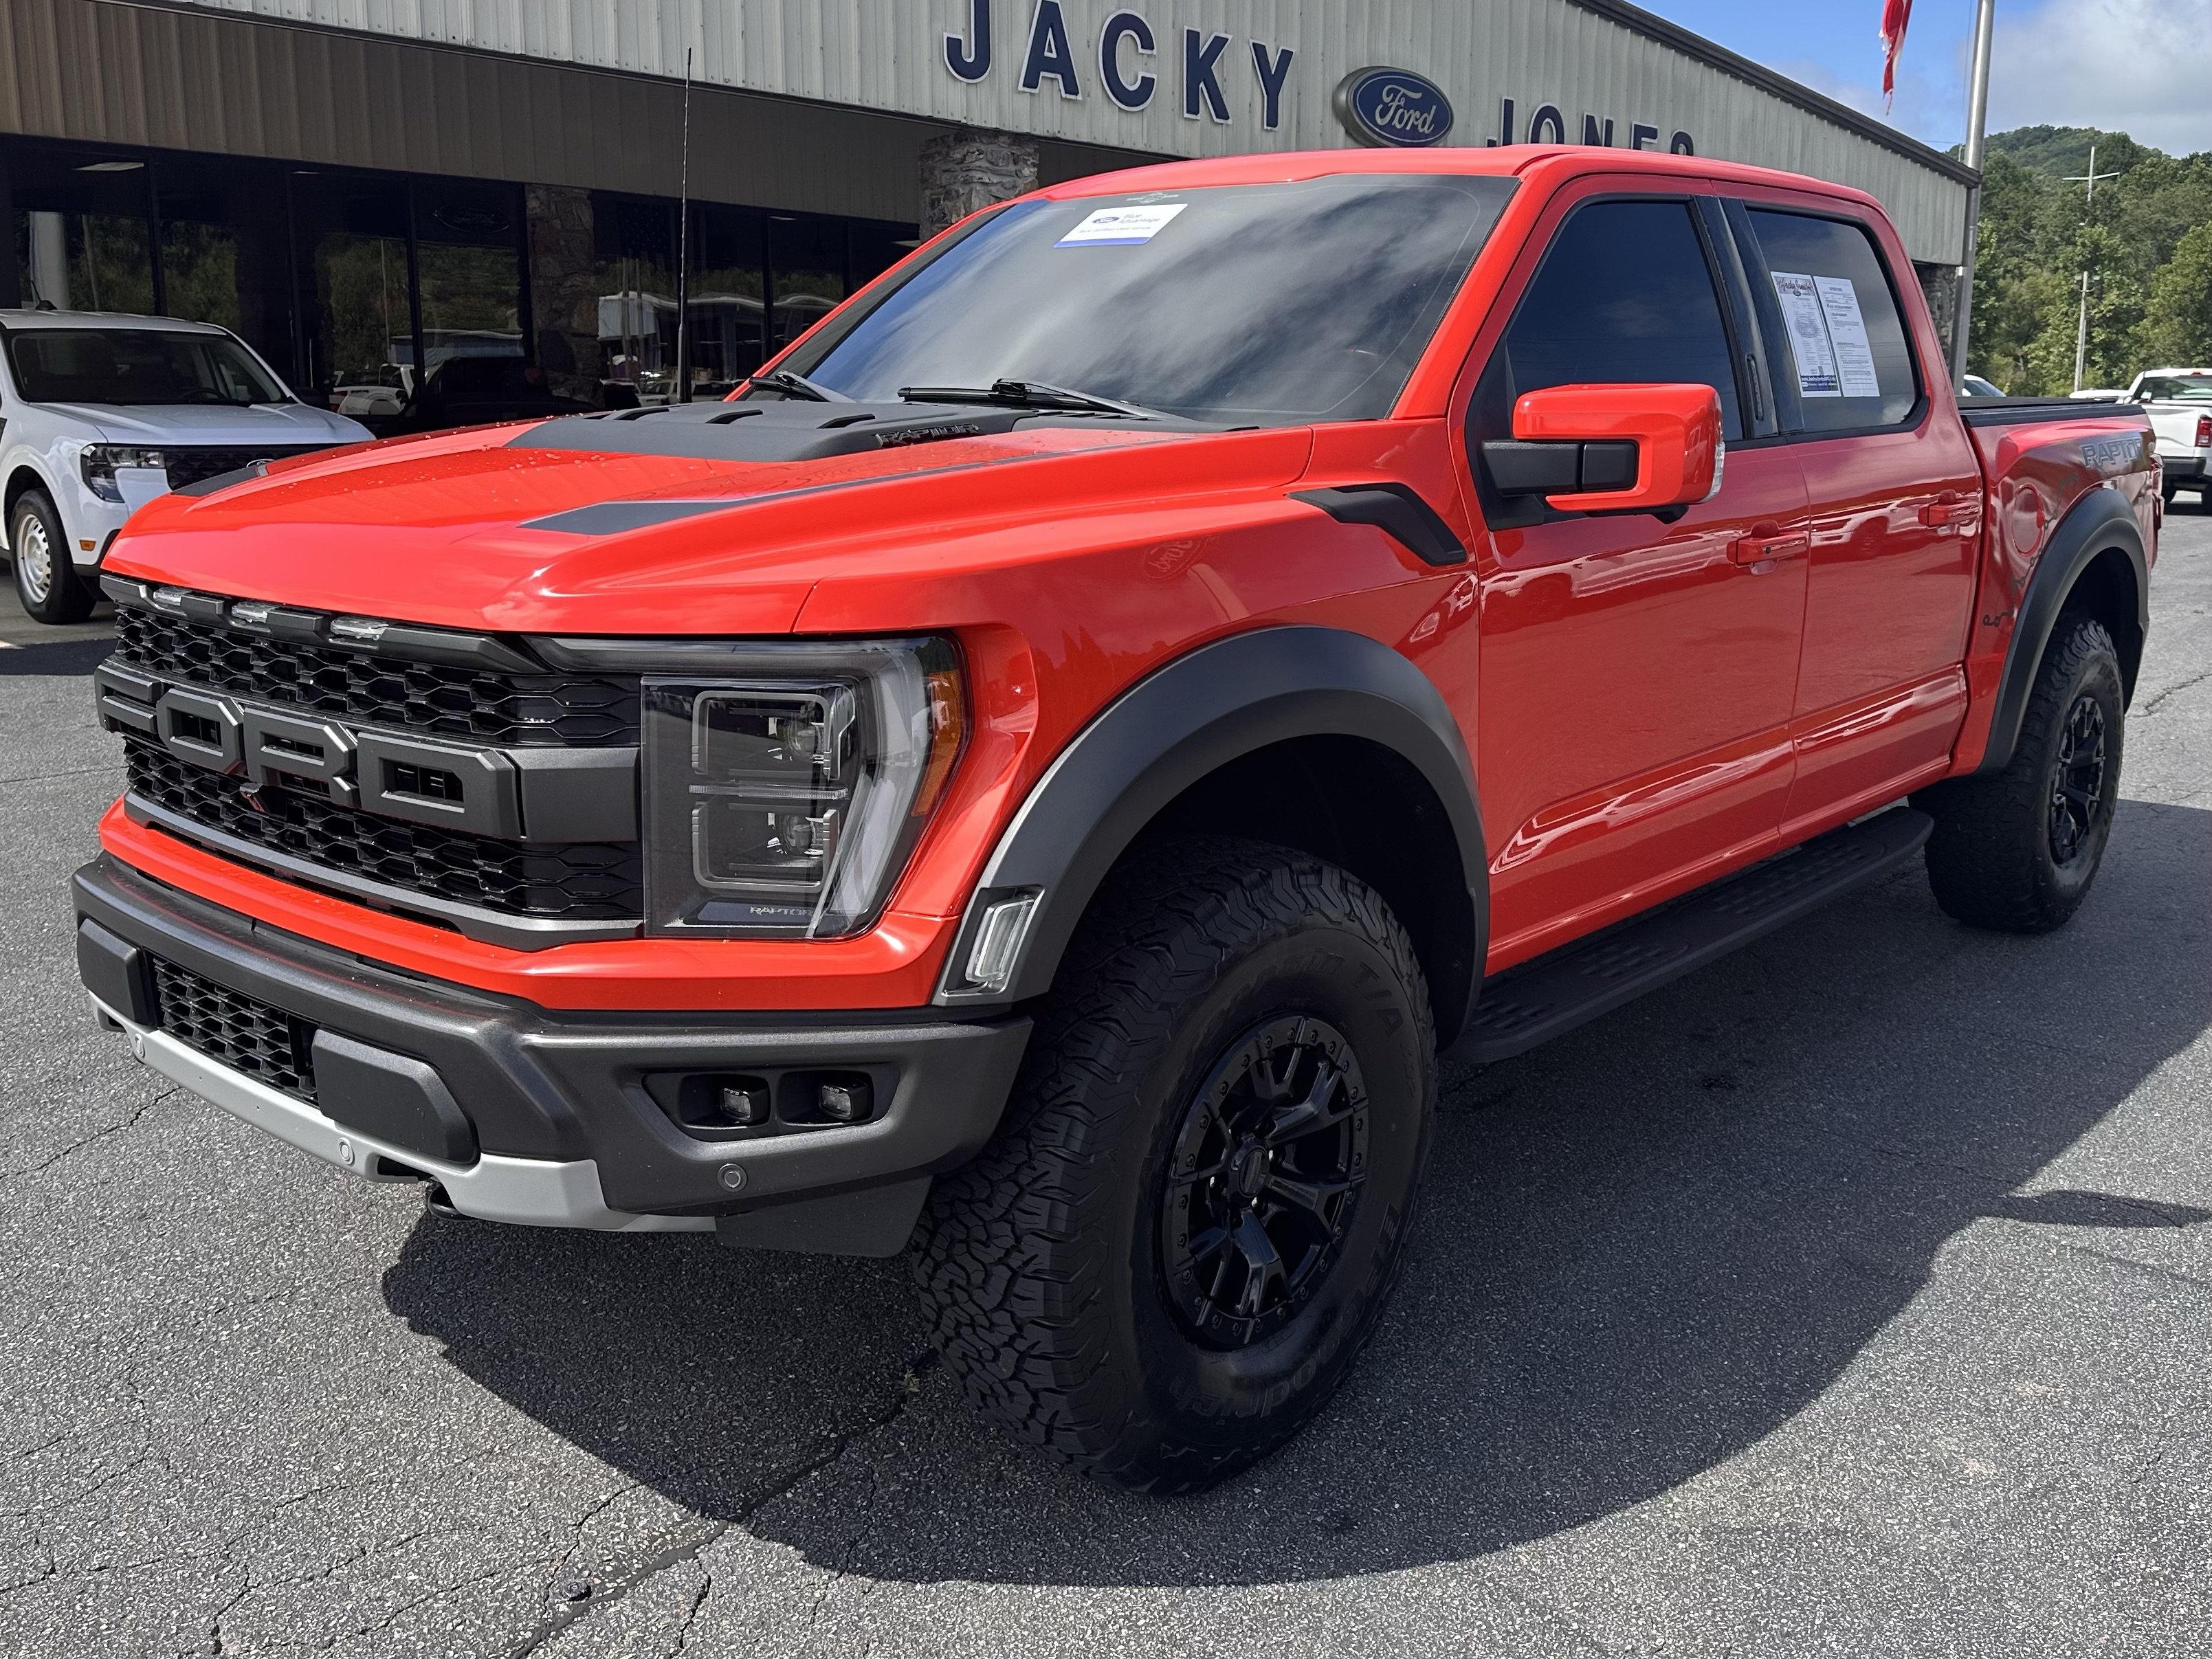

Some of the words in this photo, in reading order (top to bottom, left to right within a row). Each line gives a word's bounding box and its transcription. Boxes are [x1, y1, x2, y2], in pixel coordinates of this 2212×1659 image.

[942, 0, 1296, 131] JACKY
[1375, 85, 1437, 134] Ford
[874, 423, 979, 447] RAPTOR
[94, 664, 521, 840] FORD
[749, 906, 814, 917] RAPTOR
